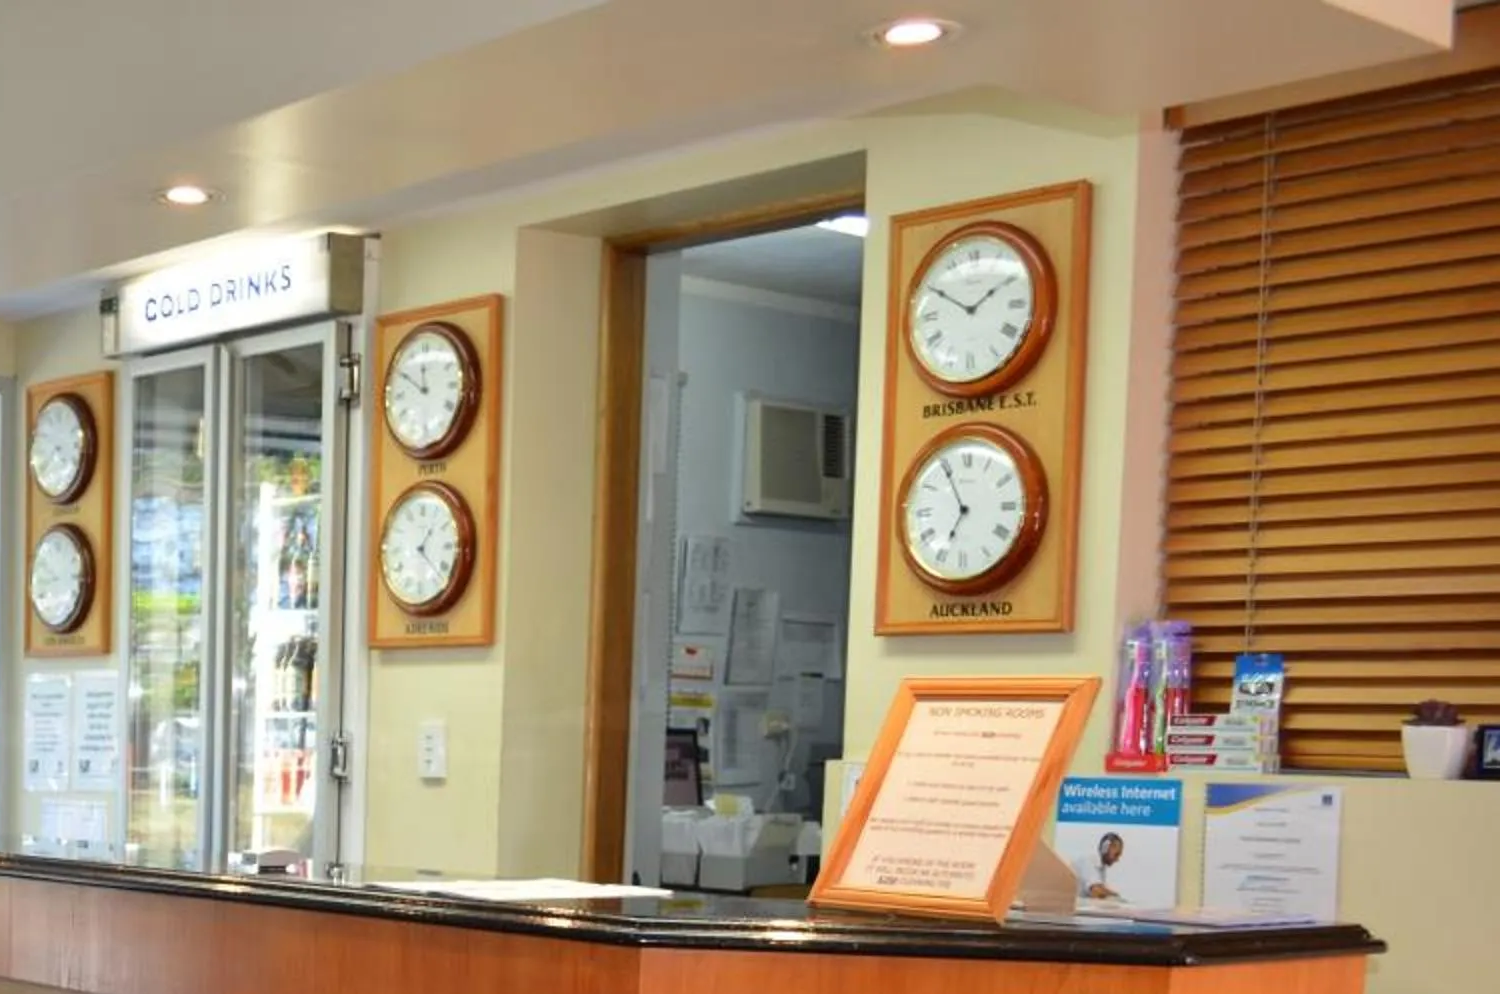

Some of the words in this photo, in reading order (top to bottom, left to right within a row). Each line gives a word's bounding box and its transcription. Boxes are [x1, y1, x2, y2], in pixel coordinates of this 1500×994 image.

[145, 288, 200, 322] COLD
[210, 265, 291, 308] DRINKS
[923, 395, 994, 418] BRISBANE
[930, 602, 1013, 617] AUCKLAND
[1063, 784, 1118, 798] Wireless
[1121, 785, 1176, 800] Internet
[1061, 801, 1118, 815] available
[1120, 802, 1152, 817] here
